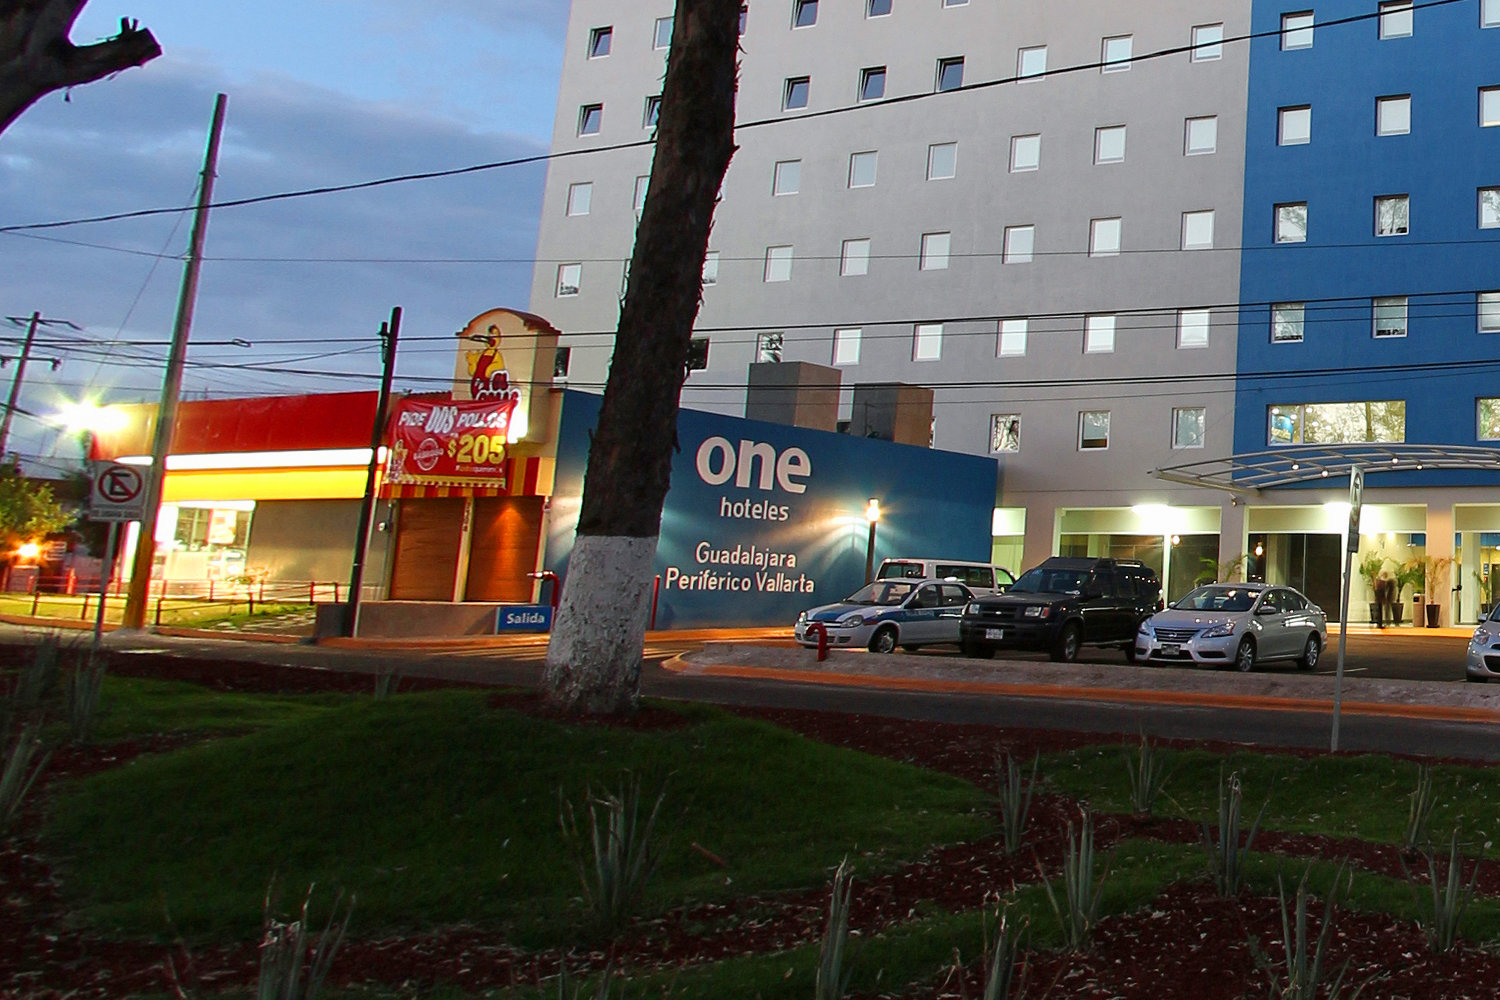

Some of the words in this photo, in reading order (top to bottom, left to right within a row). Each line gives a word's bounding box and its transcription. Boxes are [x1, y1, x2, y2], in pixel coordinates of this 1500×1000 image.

[398, 411, 428, 427] PIDE
[424, 406, 458, 434] DOS
[456, 411, 507, 428] POLLOS
[447, 434, 506, 464] $205
[696, 436, 812, 494] one
[720, 496, 789, 521] hoteles
[695, 541, 797, 571] Guadalajara
[665, 567, 752, 591] Periférico
[755, 572, 815, 593] Vallarta
[506, 612, 545, 624] Salida
